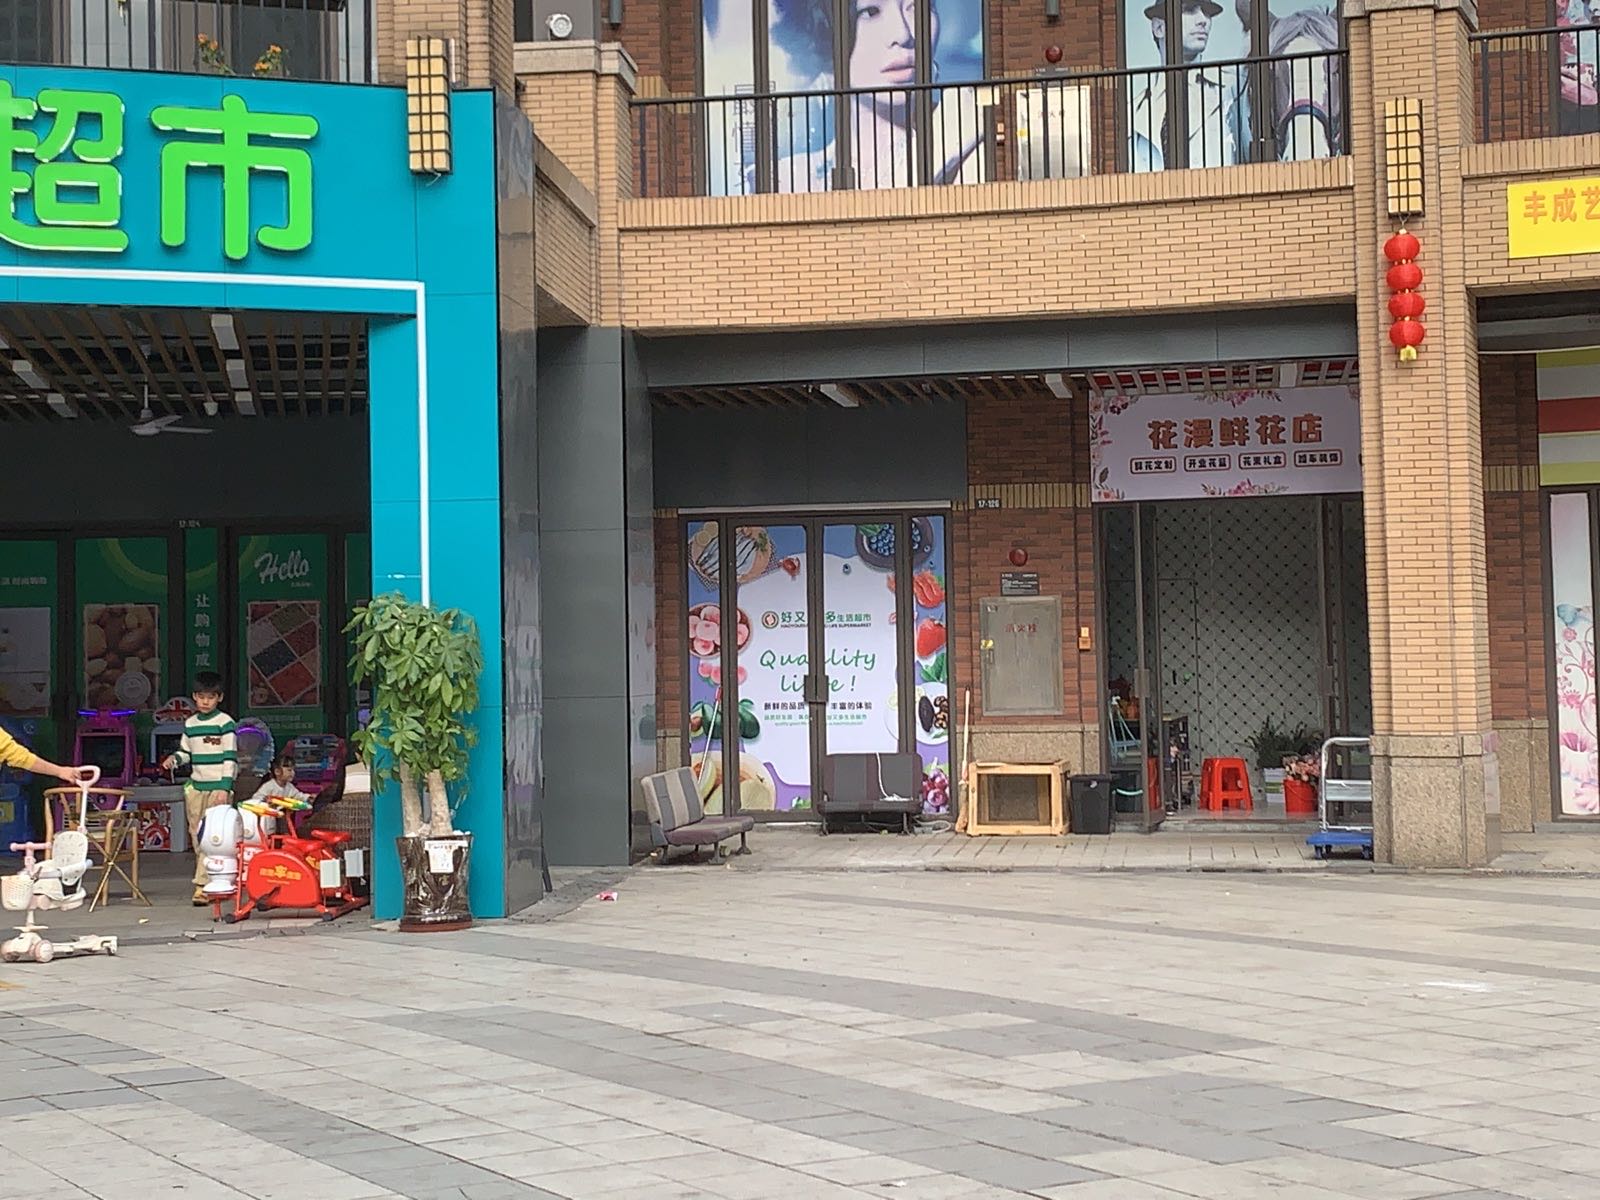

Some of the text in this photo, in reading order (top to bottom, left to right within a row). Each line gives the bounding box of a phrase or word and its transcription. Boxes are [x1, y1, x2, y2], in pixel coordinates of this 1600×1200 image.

[0, 79, 320, 260] 超市
[1523, 186, 1600, 225] 丰成艺
[1147, 413, 1323, 450] 花漫鲜花店
[255, 550, 310, 585] Hello
